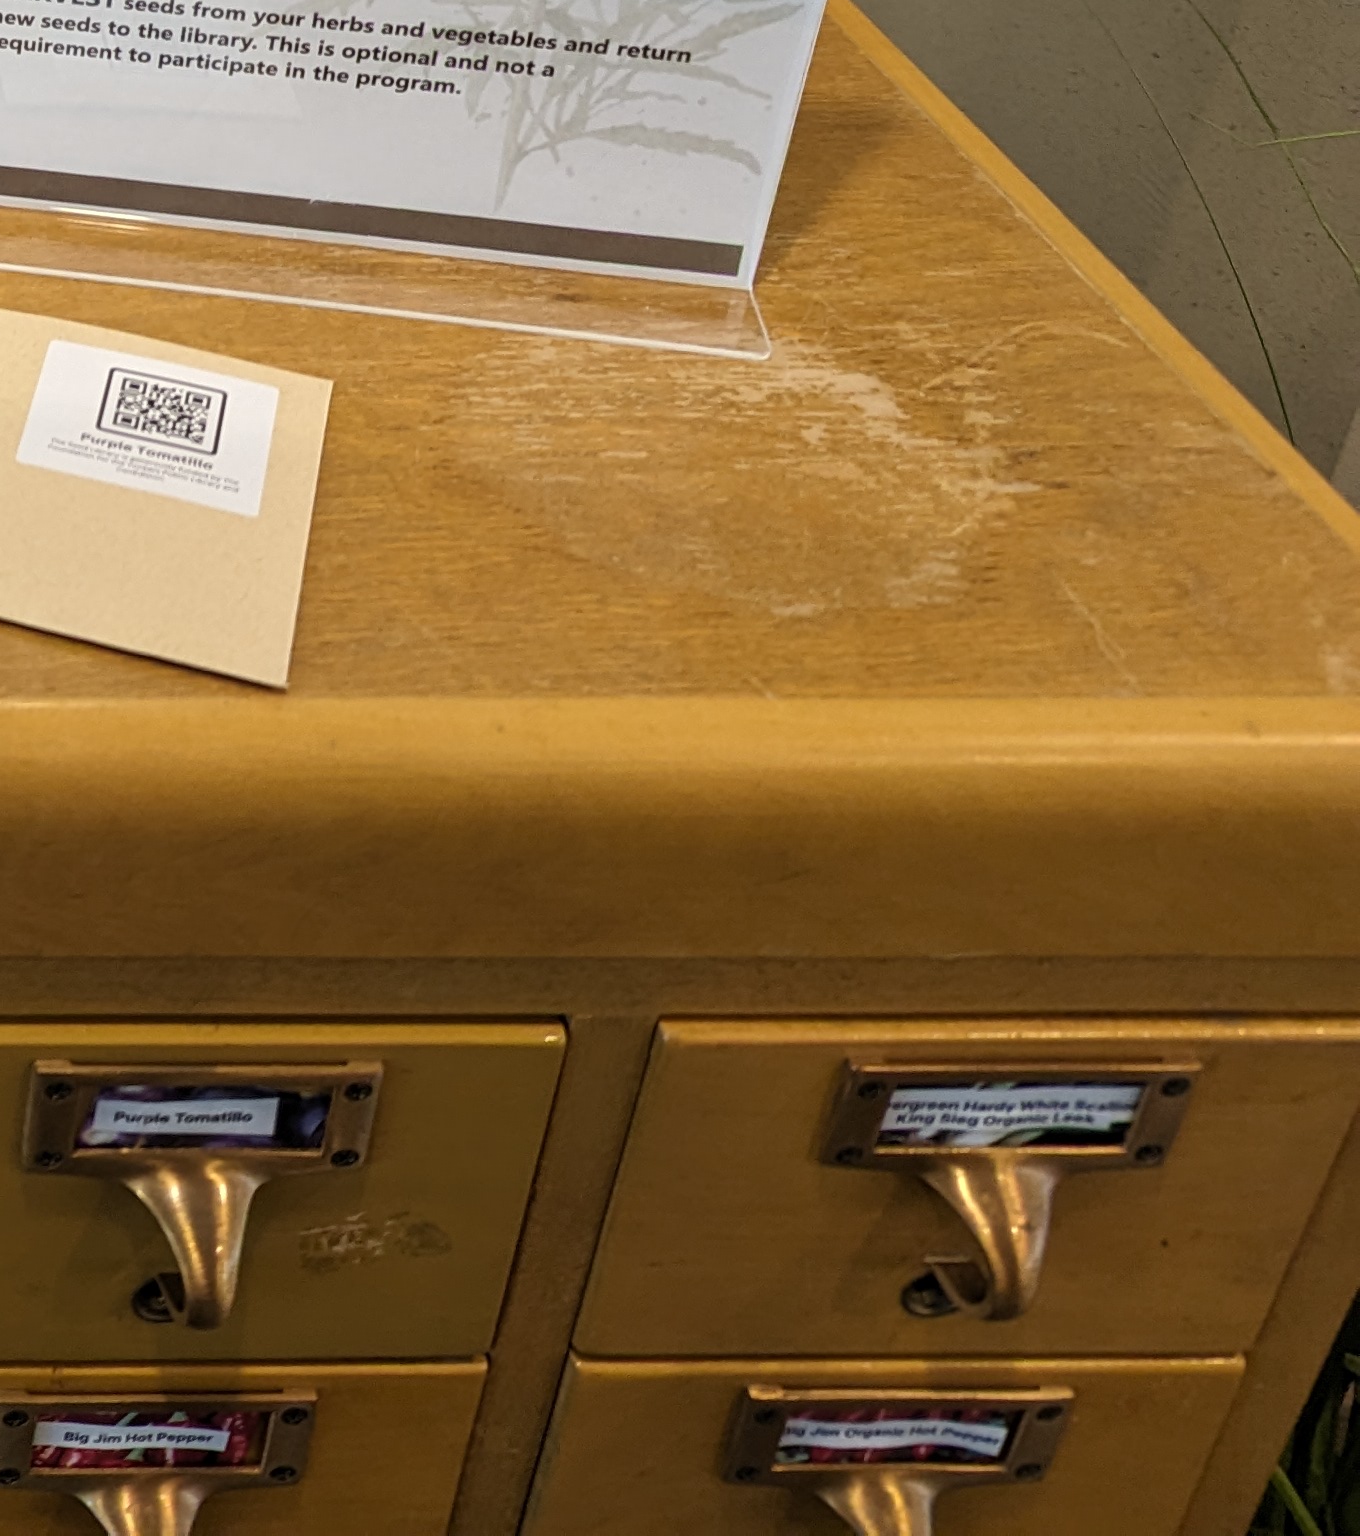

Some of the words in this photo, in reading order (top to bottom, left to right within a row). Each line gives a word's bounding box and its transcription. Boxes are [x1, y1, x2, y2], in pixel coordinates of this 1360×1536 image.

[191, 0, 246, 22] from
[251, 11, 306, 27] your
[311, 11, 375, 34] herbs
[380, 21, 425, 39] and
[431, 27, 558, 50] vegetables
[563, 38, 611, 55] and
[616, 44, 692, 64] return
[80, 432, 133, 452] Purple
[137, 445, 213, 471] Tomatillo
